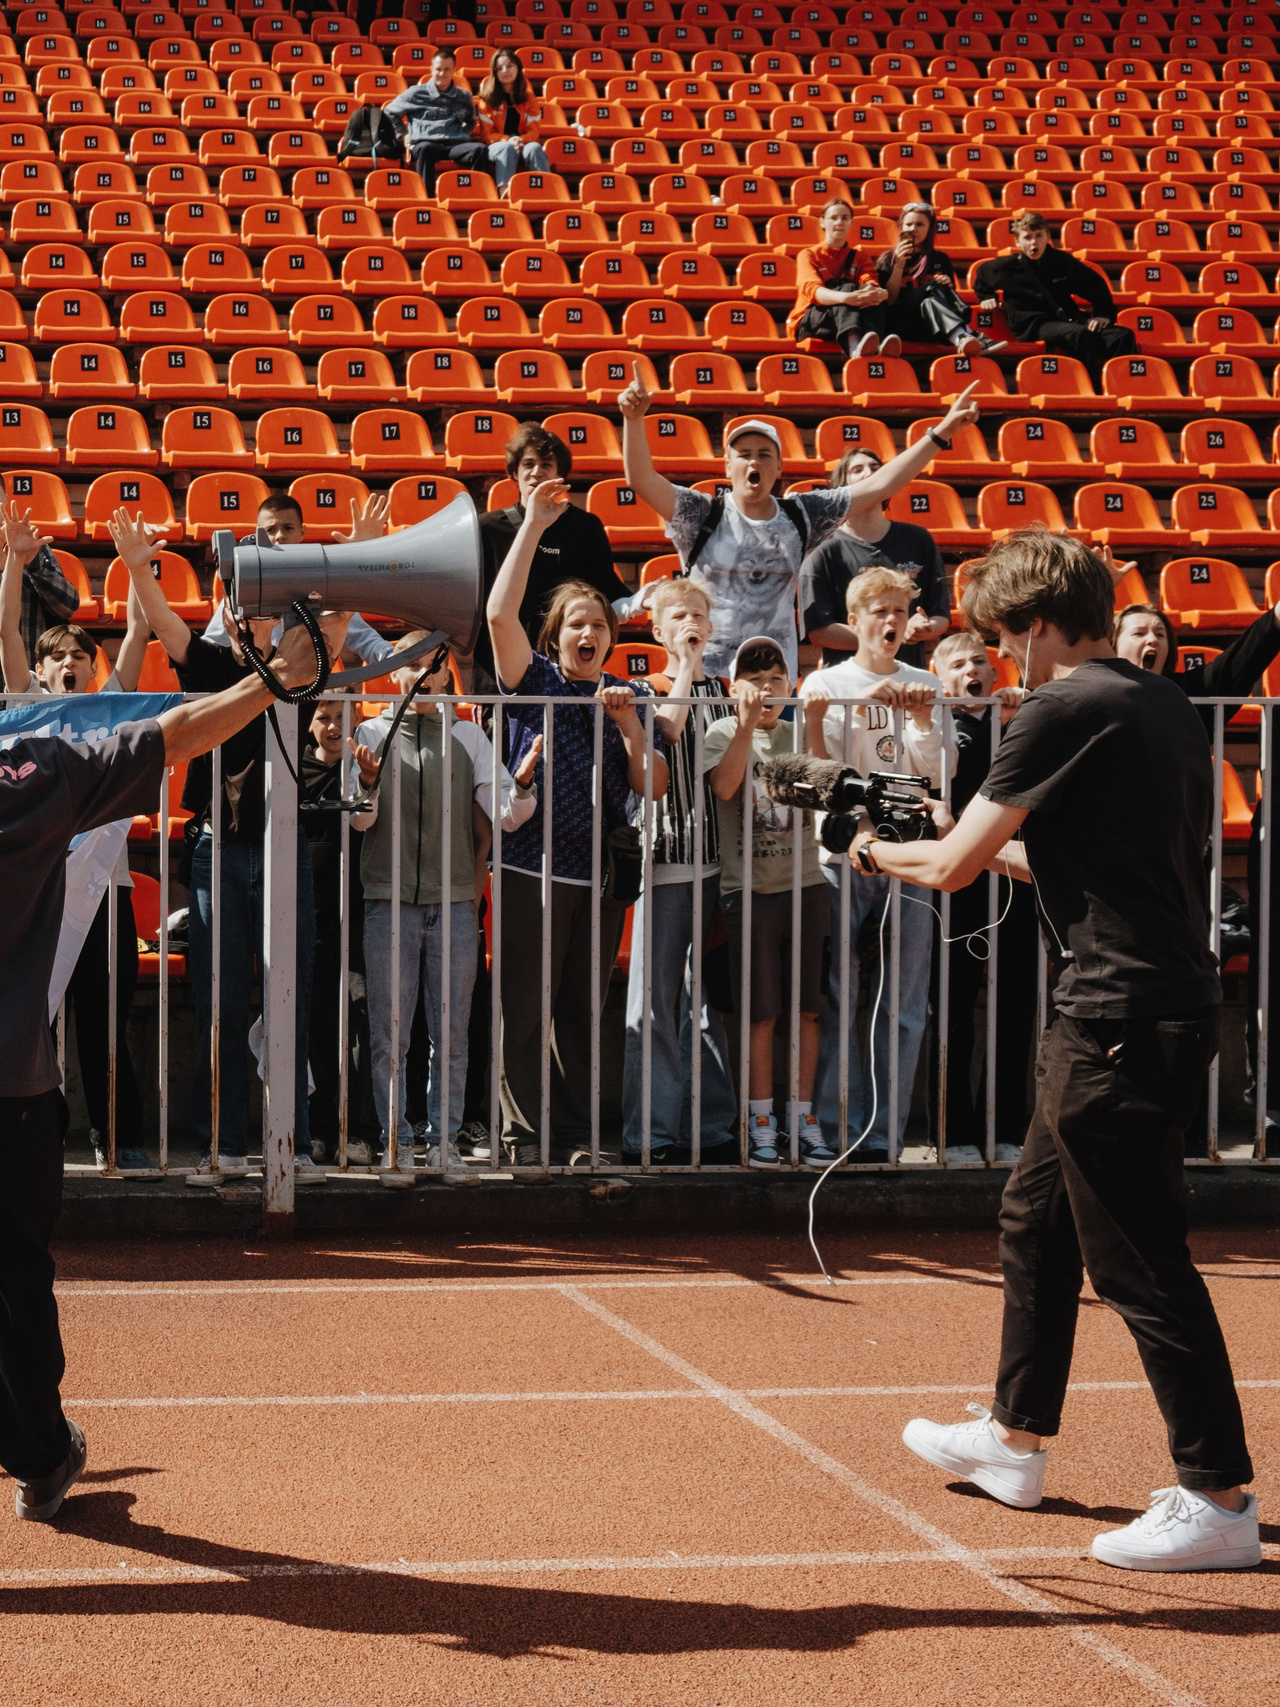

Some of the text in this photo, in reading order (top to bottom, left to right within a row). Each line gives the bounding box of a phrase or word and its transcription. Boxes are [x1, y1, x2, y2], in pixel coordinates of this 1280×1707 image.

[337, 104, 346, 112] 19
[855, 113, 864, 121] 27
[1111, 117, 1119, 125] 31
[155, 135, 164, 143] 16
[769, 144, 778, 152] 25
[459, 176, 470, 185] 20
[745, 182, 756, 191] 24
[419, 213, 429, 222] 19
[568, 218, 579, 227] 21
[938, 222, 948, 232] 26
[1083, 223, 1094, 232] 28
[52, 257, 63, 266] 14
[450, 258, 460, 267] 19
[528, 259, 540, 269] 20
[684, 262, 696, 272] 22
[1148, 270, 1159, 279] 28
[235, 304, 246, 314] 16
[404, 308, 416, 317] 18
[487, 309, 498, 318] 19
[569, 311, 581, 320] 20
[980, 315, 991, 326] 25
[1140, 319, 1151, 328] 27
[1221, 318, 1233, 327] 28
[84, 358, 96, 368] 14
[171, 355, 183, 365] 15
[437, 357, 449, 367] 18
[258, 361, 270, 371] 16
[524, 365, 535, 375] 19
[784, 361, 797, 371] 22
[957, 360, 969, 371] 24
[1218, 364, 1230, 374] 27
[610, 367, 623, 377] 20
[6, 412, 18, 423] 13
[101, 416, 113, 426] 14
[196, 416, 209, 426] 15
[478, 420, 490, 430] 18
[660, 423, 674, 433] 20
[287, 431, 299, 442] 16
[385, 426, 397, 437] 17
[572, 430, 584, 441] 19
[845, 427, 858, 438] 22
[1028, 426, 1042, 437] 24
[1121, 429, 1135, 440] 25
[1210, 434, 1223, 445] 26
[17, 480, 30, 491] 13
[421, 485, 434, 496] 17
[123, 486, 137, 497] 14
[620, 490, 633, 502] 19
[1009, 491, 1023, 502] 23
[223, 495, 237, 507] 15
[319, 493, 332, 504] 16
[1107, 497, 1121, 508] 24
[1201, 495, 1215, 506] 25
[913, 498, 928, 510] 22
[1192, 568, 1208, 580] 24
[631, 658, 646, 671] 18
